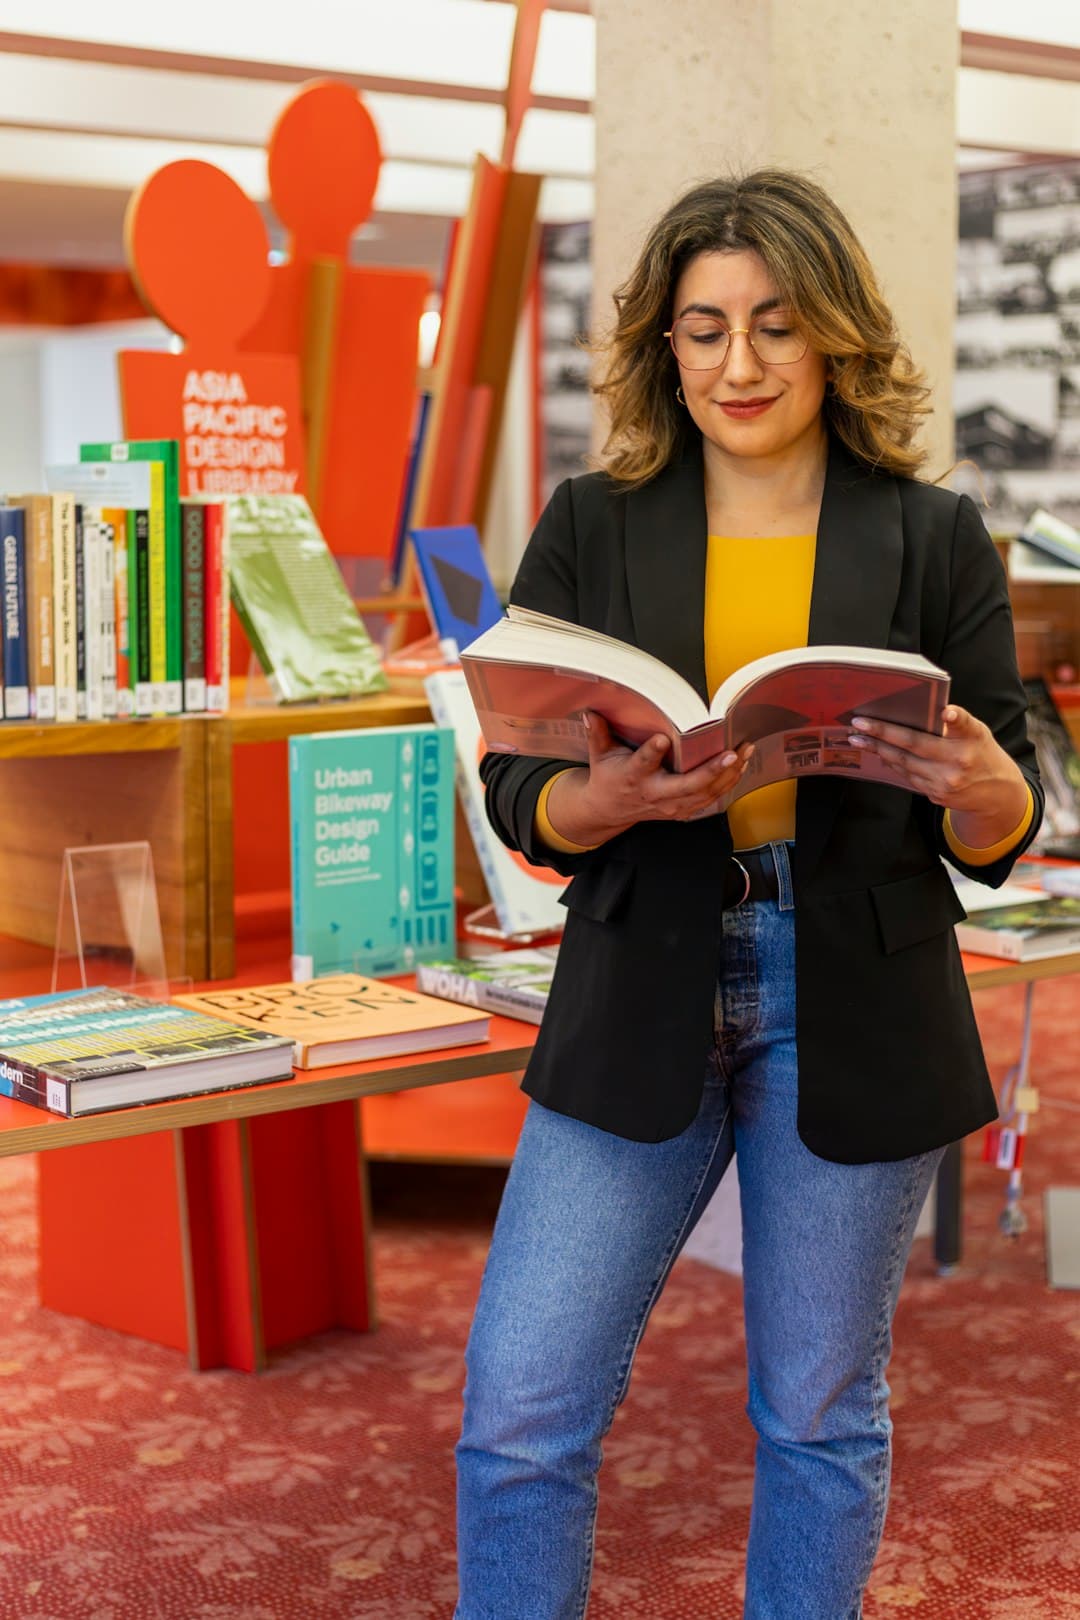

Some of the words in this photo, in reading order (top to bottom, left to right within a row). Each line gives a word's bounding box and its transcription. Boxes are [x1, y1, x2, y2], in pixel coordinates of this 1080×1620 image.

[183, 370, 247, 402] ASIA
[183, 403, 288, 437] PACIFIC
[185, 436, 284, 469] DESIGN
[187, 469, 298, 495] LIBRARY
[187, 510, 203, 568] GOOD
[4, 535, 17, 582] GREEN
[187, 571, 203, 594] BY
[5, 583, 19, 639] FUTURE
[61, 583, 71, 617] Design
[187, 596, 203, 663] DESIGN
[314, 766, 374, 790] Urban
[314, 791, 394, 816] Bikeway
[314, 816, 380, 842] Design
[314, 842, 371, 867] Guide
[419, 966, 480, 1007] WOHA
